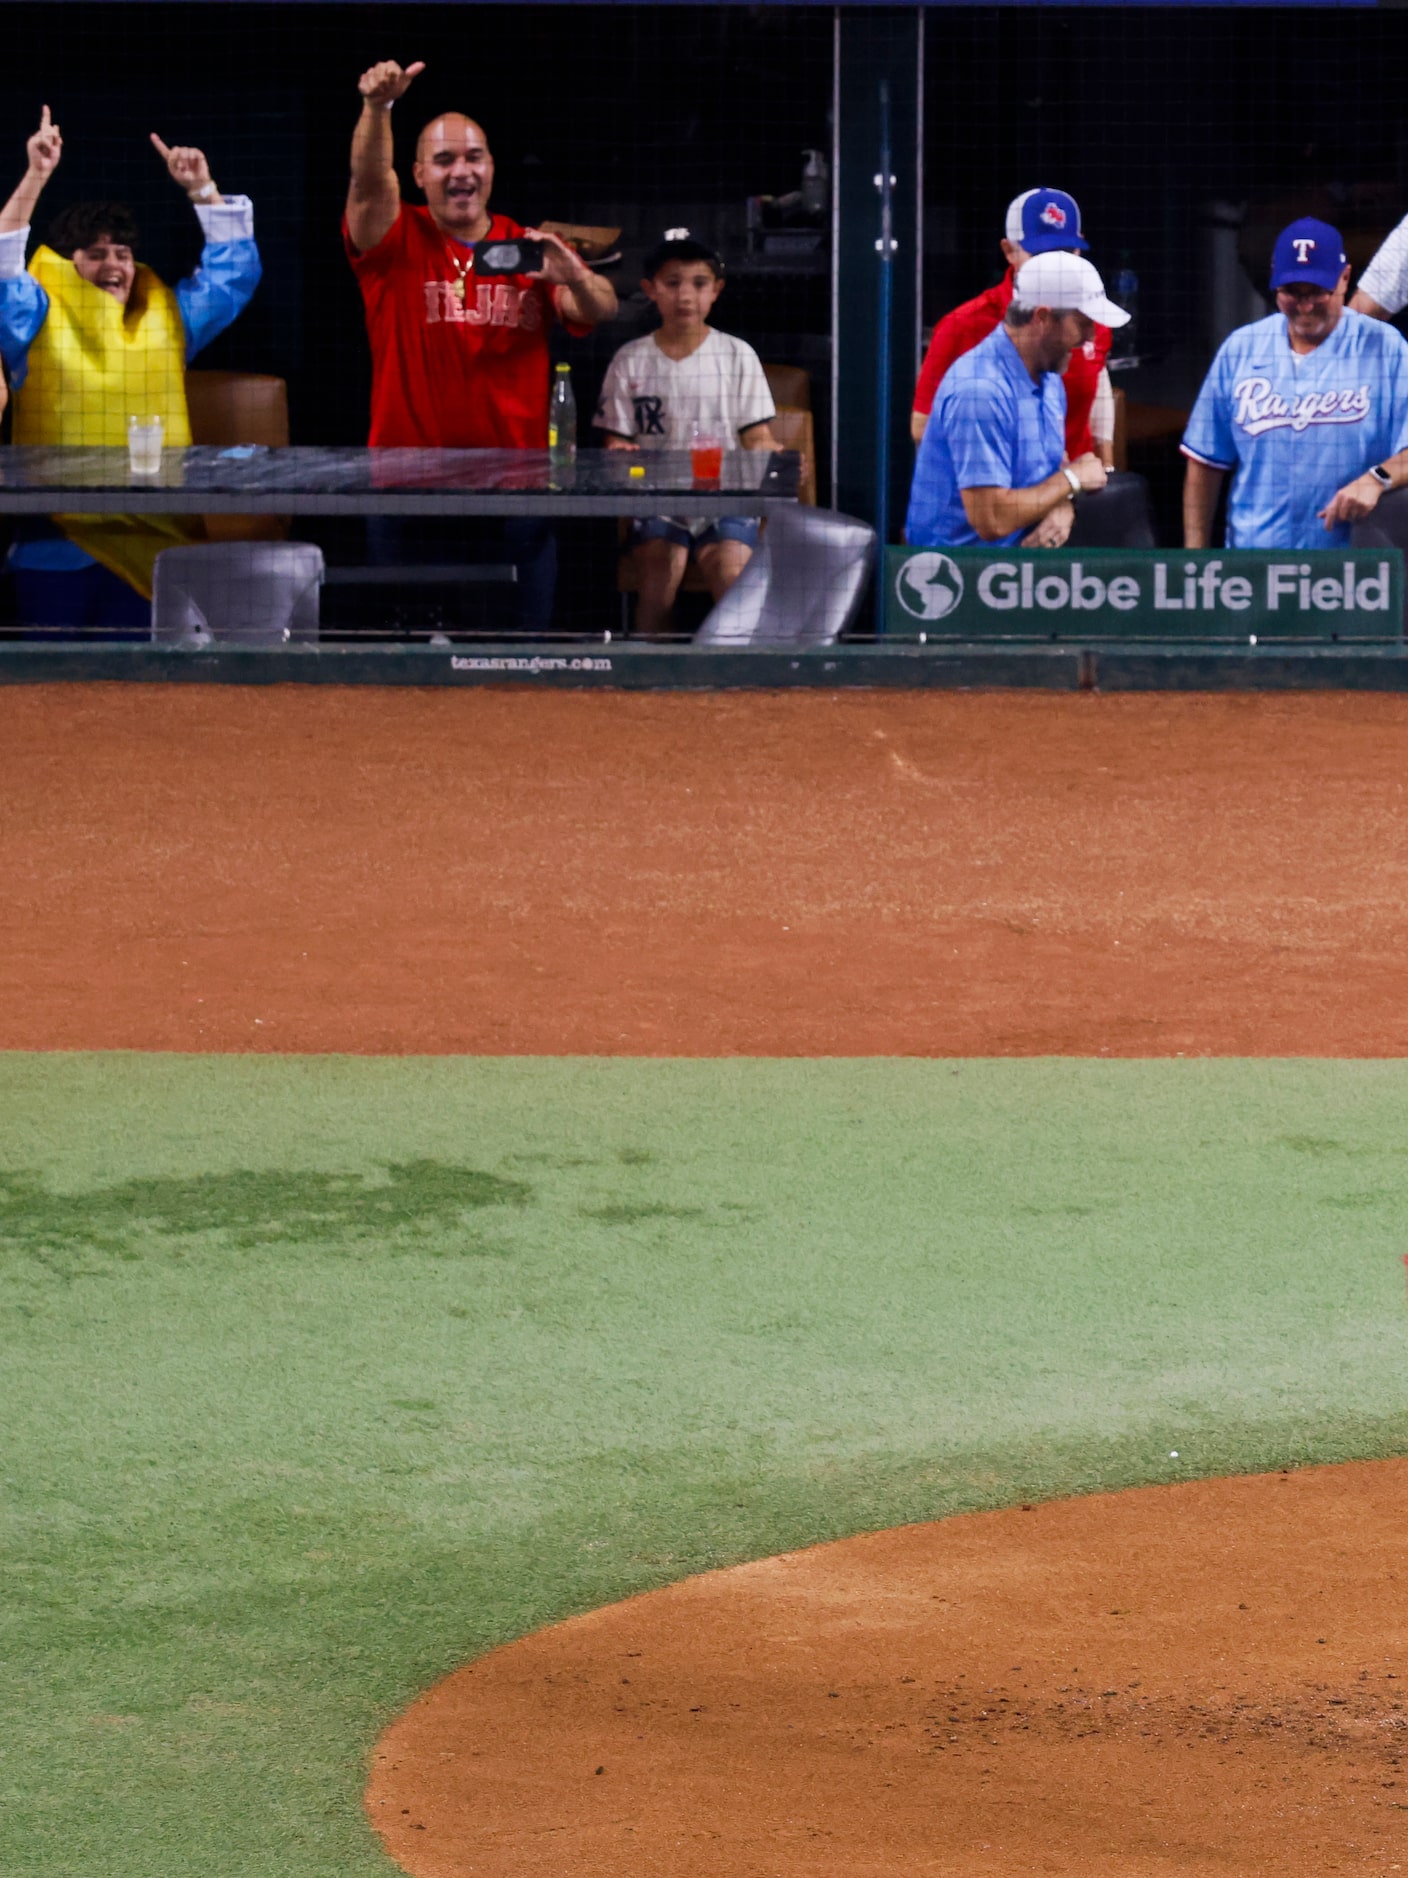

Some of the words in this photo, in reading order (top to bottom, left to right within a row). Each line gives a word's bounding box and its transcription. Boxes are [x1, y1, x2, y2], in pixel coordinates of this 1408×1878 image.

[1292, 238, 1316, 263] T
[424, 280, 541, 331] TEJAS
[1234, 377, 1371, 437] Rangers
[977, 562, 1140, 610] Globe
[1154, 560, 1253, 610] Life
[1266, 560, 1391, 611] Field
[451, 655, 613, 675] texasrangers.com
